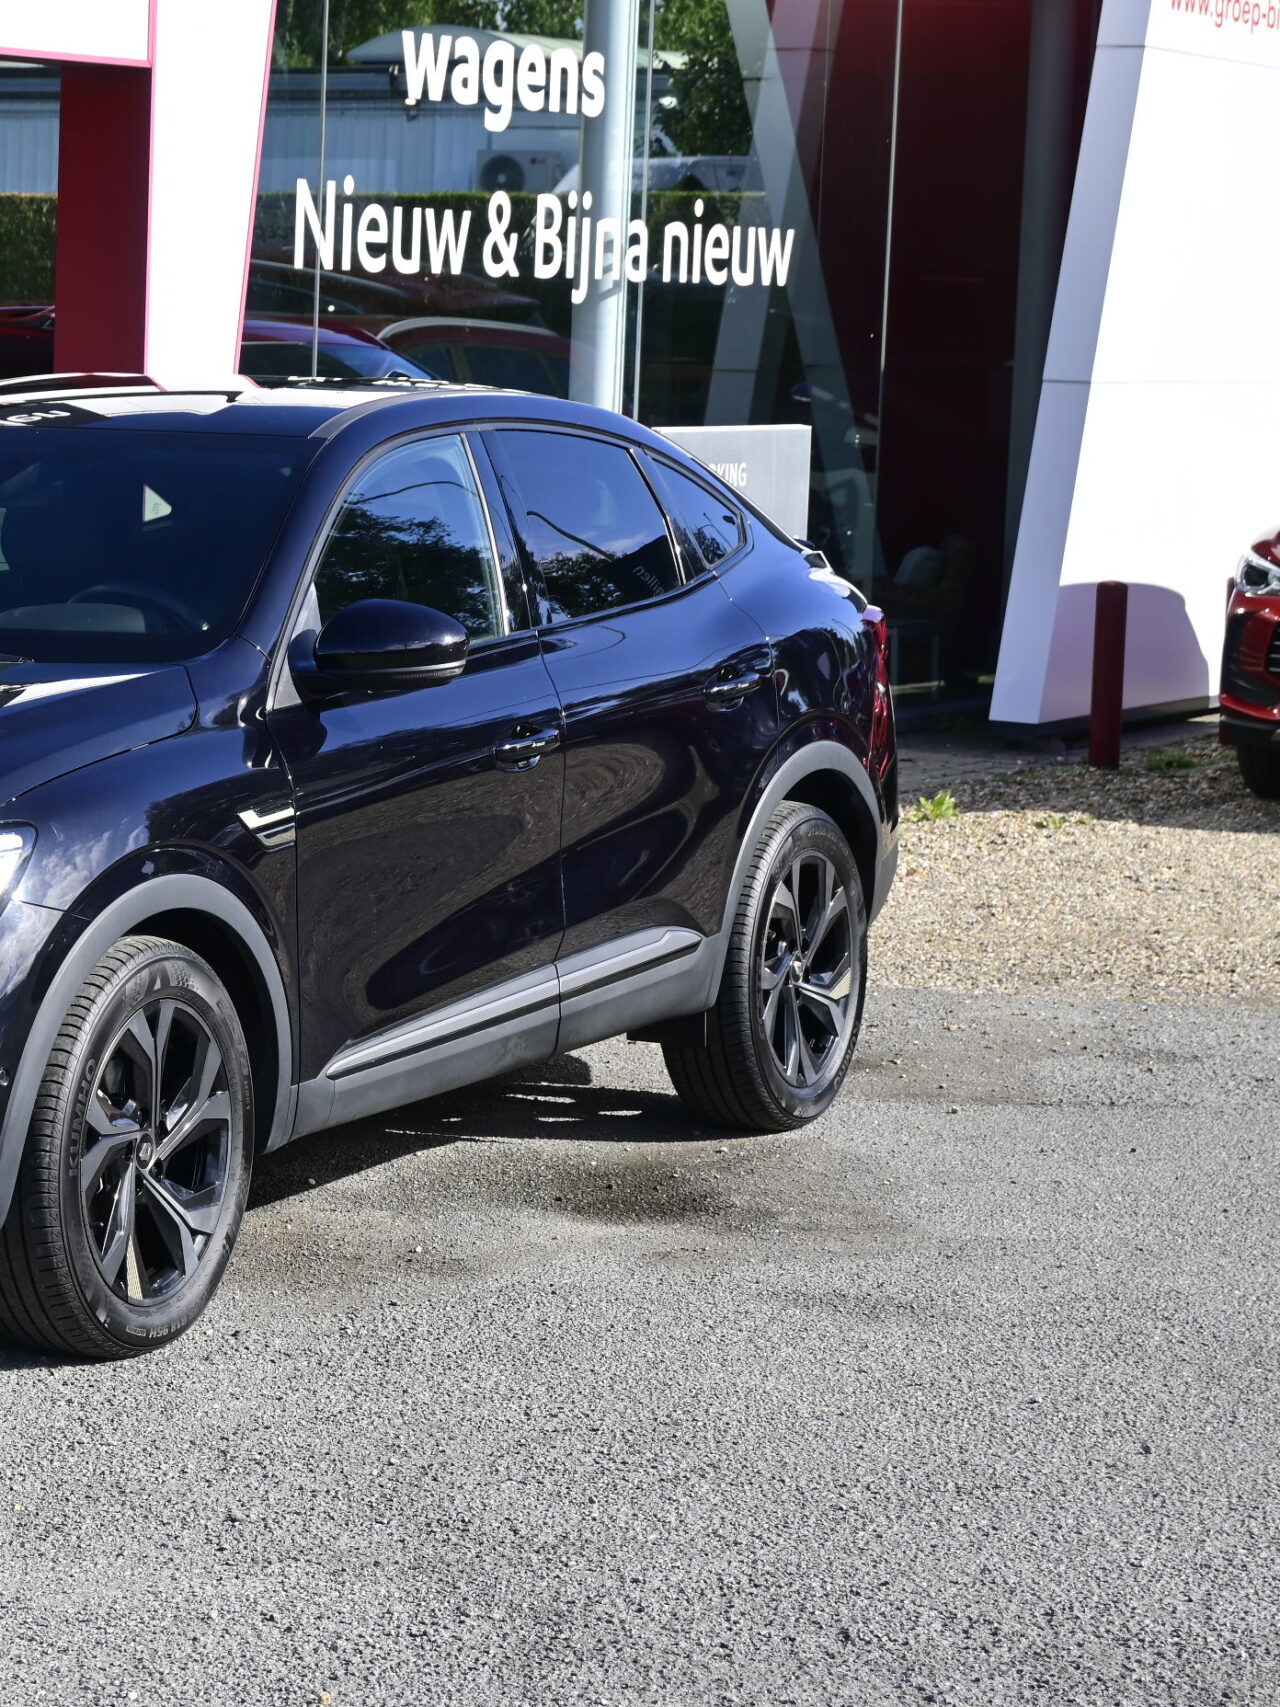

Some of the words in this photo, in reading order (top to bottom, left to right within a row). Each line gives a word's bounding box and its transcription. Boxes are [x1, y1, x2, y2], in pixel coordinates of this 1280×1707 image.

[402, 30, 606, 133] wagens
[293, 175, 472, 276] Nieuw
[482, 190, 520, 279] &
[533, 190, 649, 305] Bijna
[662, 198, 795, 287] nieuw
[68, 1058, 97, 1177] KUMHO
